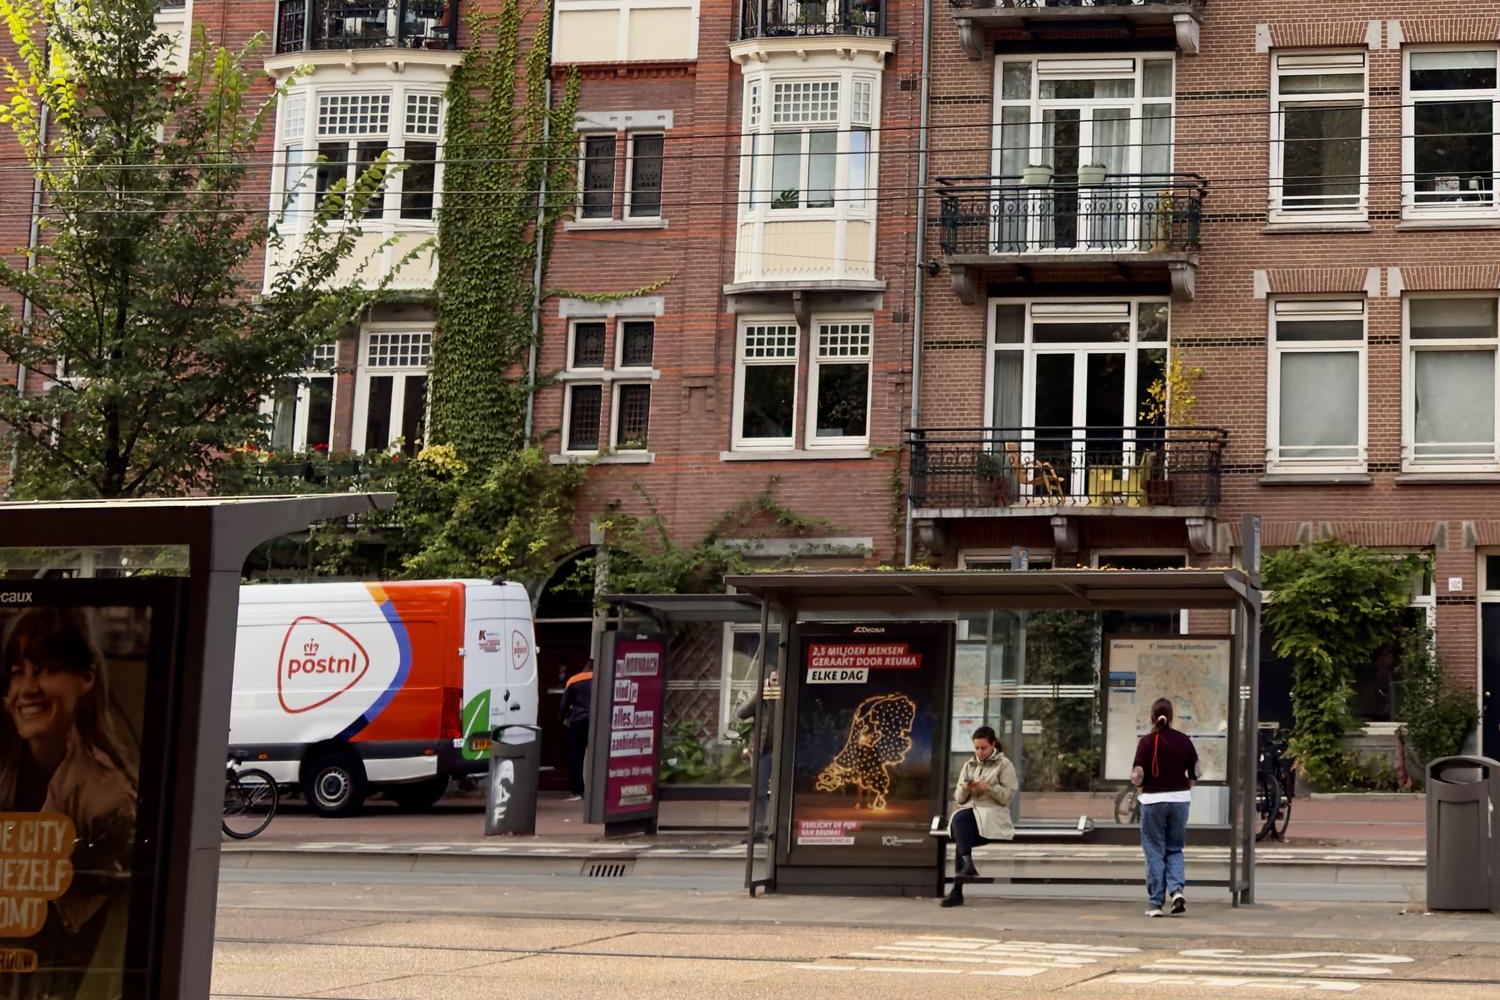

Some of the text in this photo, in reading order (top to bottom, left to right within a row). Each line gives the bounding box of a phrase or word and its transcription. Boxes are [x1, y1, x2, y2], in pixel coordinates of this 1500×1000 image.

[0, 592, 33, 603] caux
[827, 647, 866, 658] MILJOEN
[867, 646, 905, 655] MENSEN
[288, 652, 357, 680] postnl
[812, 657, 917, 667] GERAAKT DOOR REUMA
[811, 670, 864, 681] ELKE DAG
[19, 820, 66, 853] CITY
